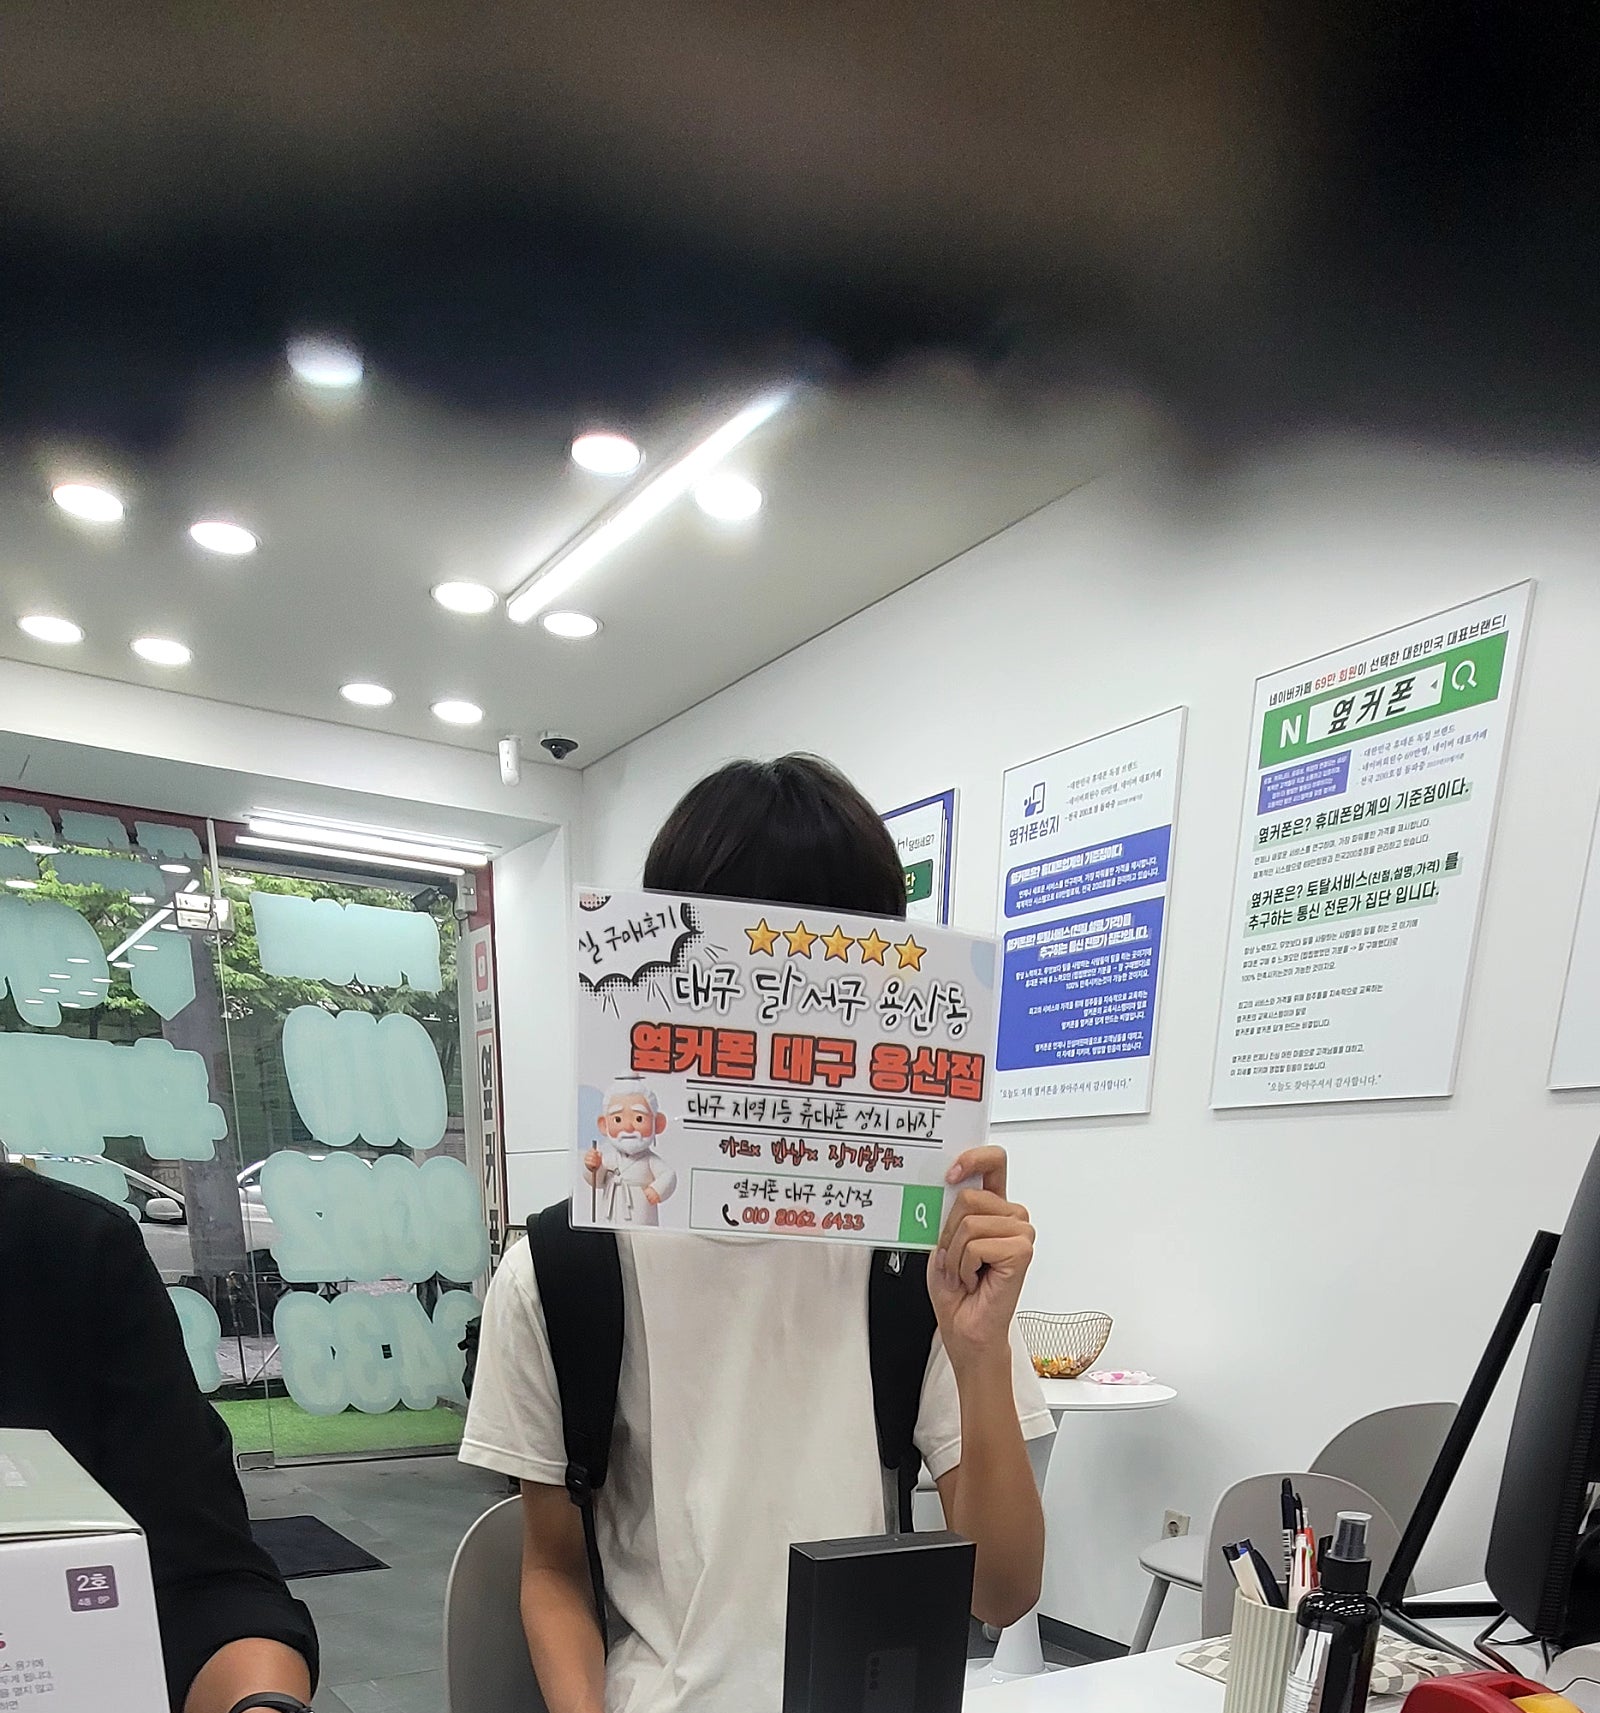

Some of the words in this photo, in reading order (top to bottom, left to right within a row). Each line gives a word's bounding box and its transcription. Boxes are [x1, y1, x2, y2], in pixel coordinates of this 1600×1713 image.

[1314, 673, 1335, 690] 69만
[1370, 650, 1399, 672] 선택한
[1402, 635, 1443, 660] 대한민국
[1259, 817, 1311, 843] 옆커폰은?
[1316, 796, 1390, 828] 휴대폰업계의
[1396, 778, 1468, 808] 기준점이다.
[1248, 909, 1292, 930] 추구하는
[1296, 902, 1319, 921] 통신
[1324, 895, 1360, 916] 전문가
[1365, 889, 1390, 909] 집단
[1395, 880, 1438, 903] 입니다.
[1251, 884, 1302, 908] 옆커폰은?
[579, 931, 603, 964] 실
[604, 905, 677, 951] 구매후기
[675, 963, 741, 1010] 대구
[880, 981, 968, 1035] 용산동
[630, 1020, 758, 1080] 옆커폰
[770, 1032, 857, 1088] 대구
[869, 1041, 985, 1103] 용산점
[687, 1092, 725, 1118] 대구
[732, 1097, 766, 1121] 지역
[772, 1098, 793, 1123] 1등
[800, 1098, 848, 1130] 휴대폰
[855, 1106, 889, 1131] 성지
[896, 1108, 942, 1138] 매장
[733, 1179, 780, 1202] 옆커폰
[785, 1182, 817, 1204] 대구
[822, 1183, 873, 1208] 용산점
[742, 1206, 770, 1225] 010
[774, 1208, 817, 1228] 8062
[822, 1211, 866, 1231] 6433
[76, 1573, 110, 1592] 2호
